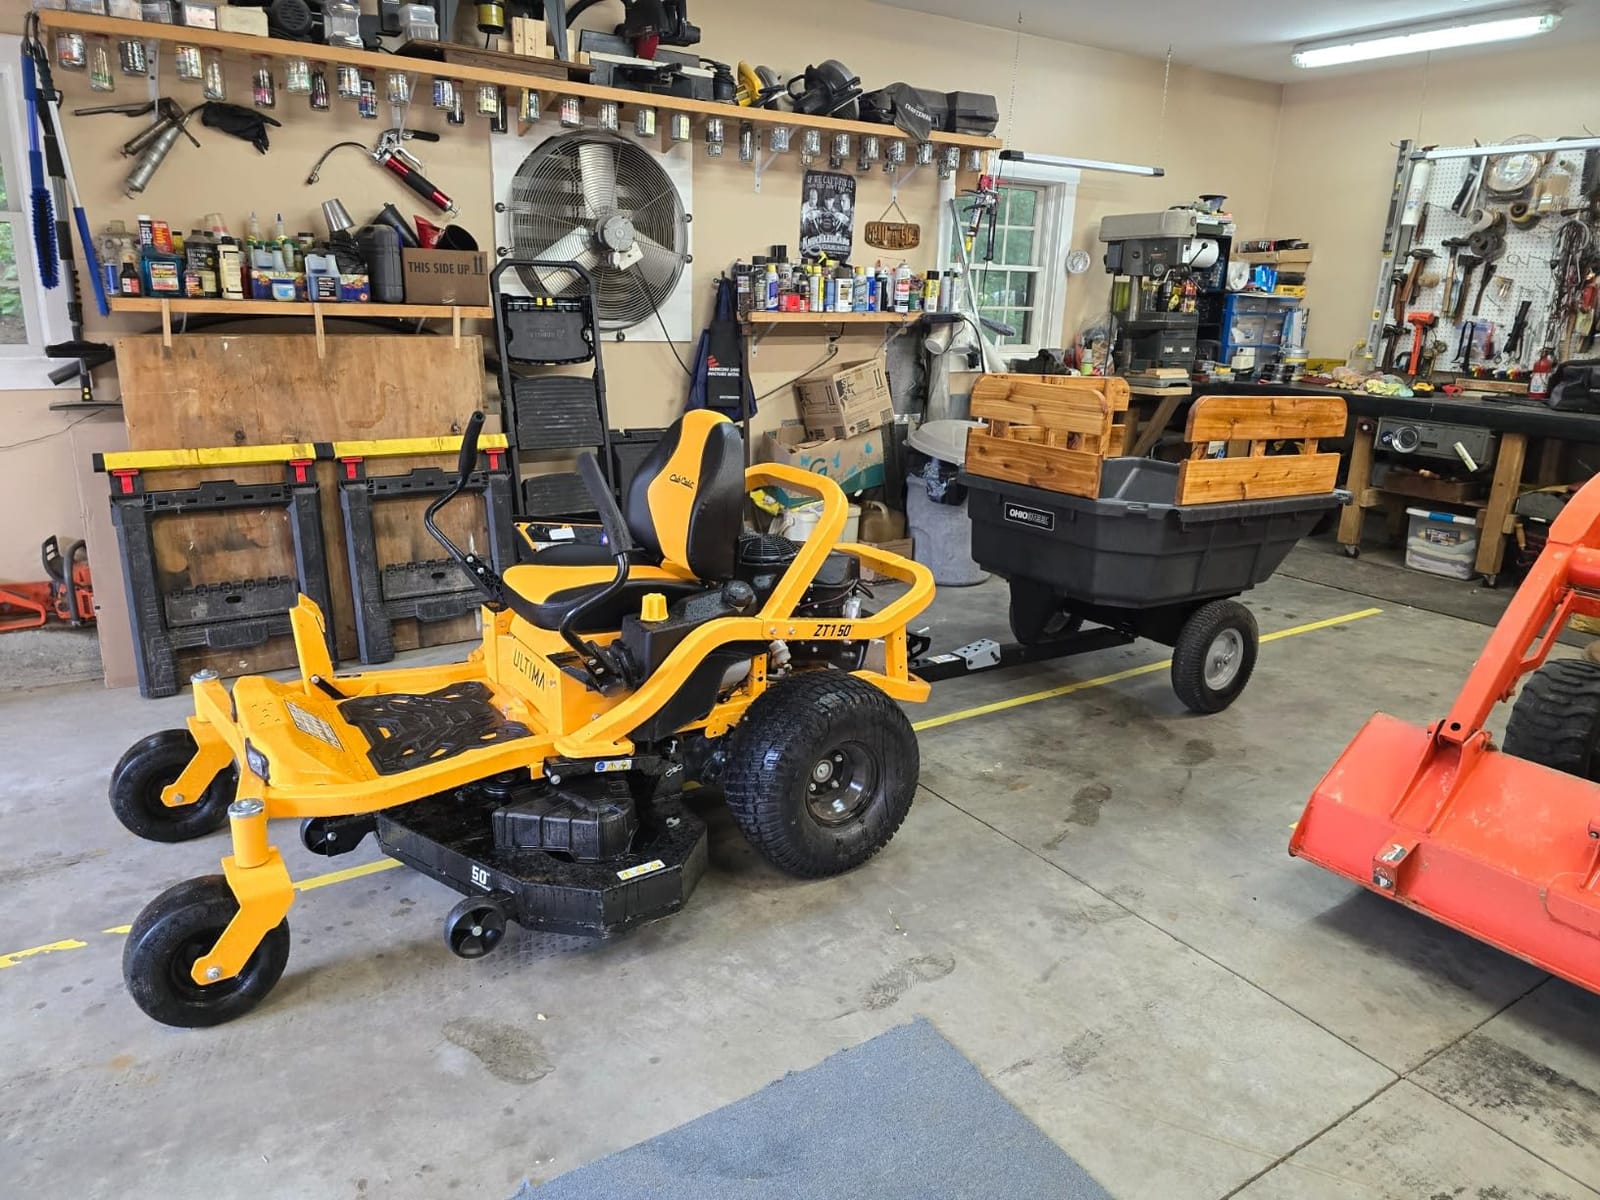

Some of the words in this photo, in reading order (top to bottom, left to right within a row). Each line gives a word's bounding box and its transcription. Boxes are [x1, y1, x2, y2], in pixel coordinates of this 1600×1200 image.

[408, 261, 430, 273] THIS
[433, 262, 455, 274] SIDE
[457, 264, 470, 275] UP
[513, 648, 545, 692] ULTIMA
